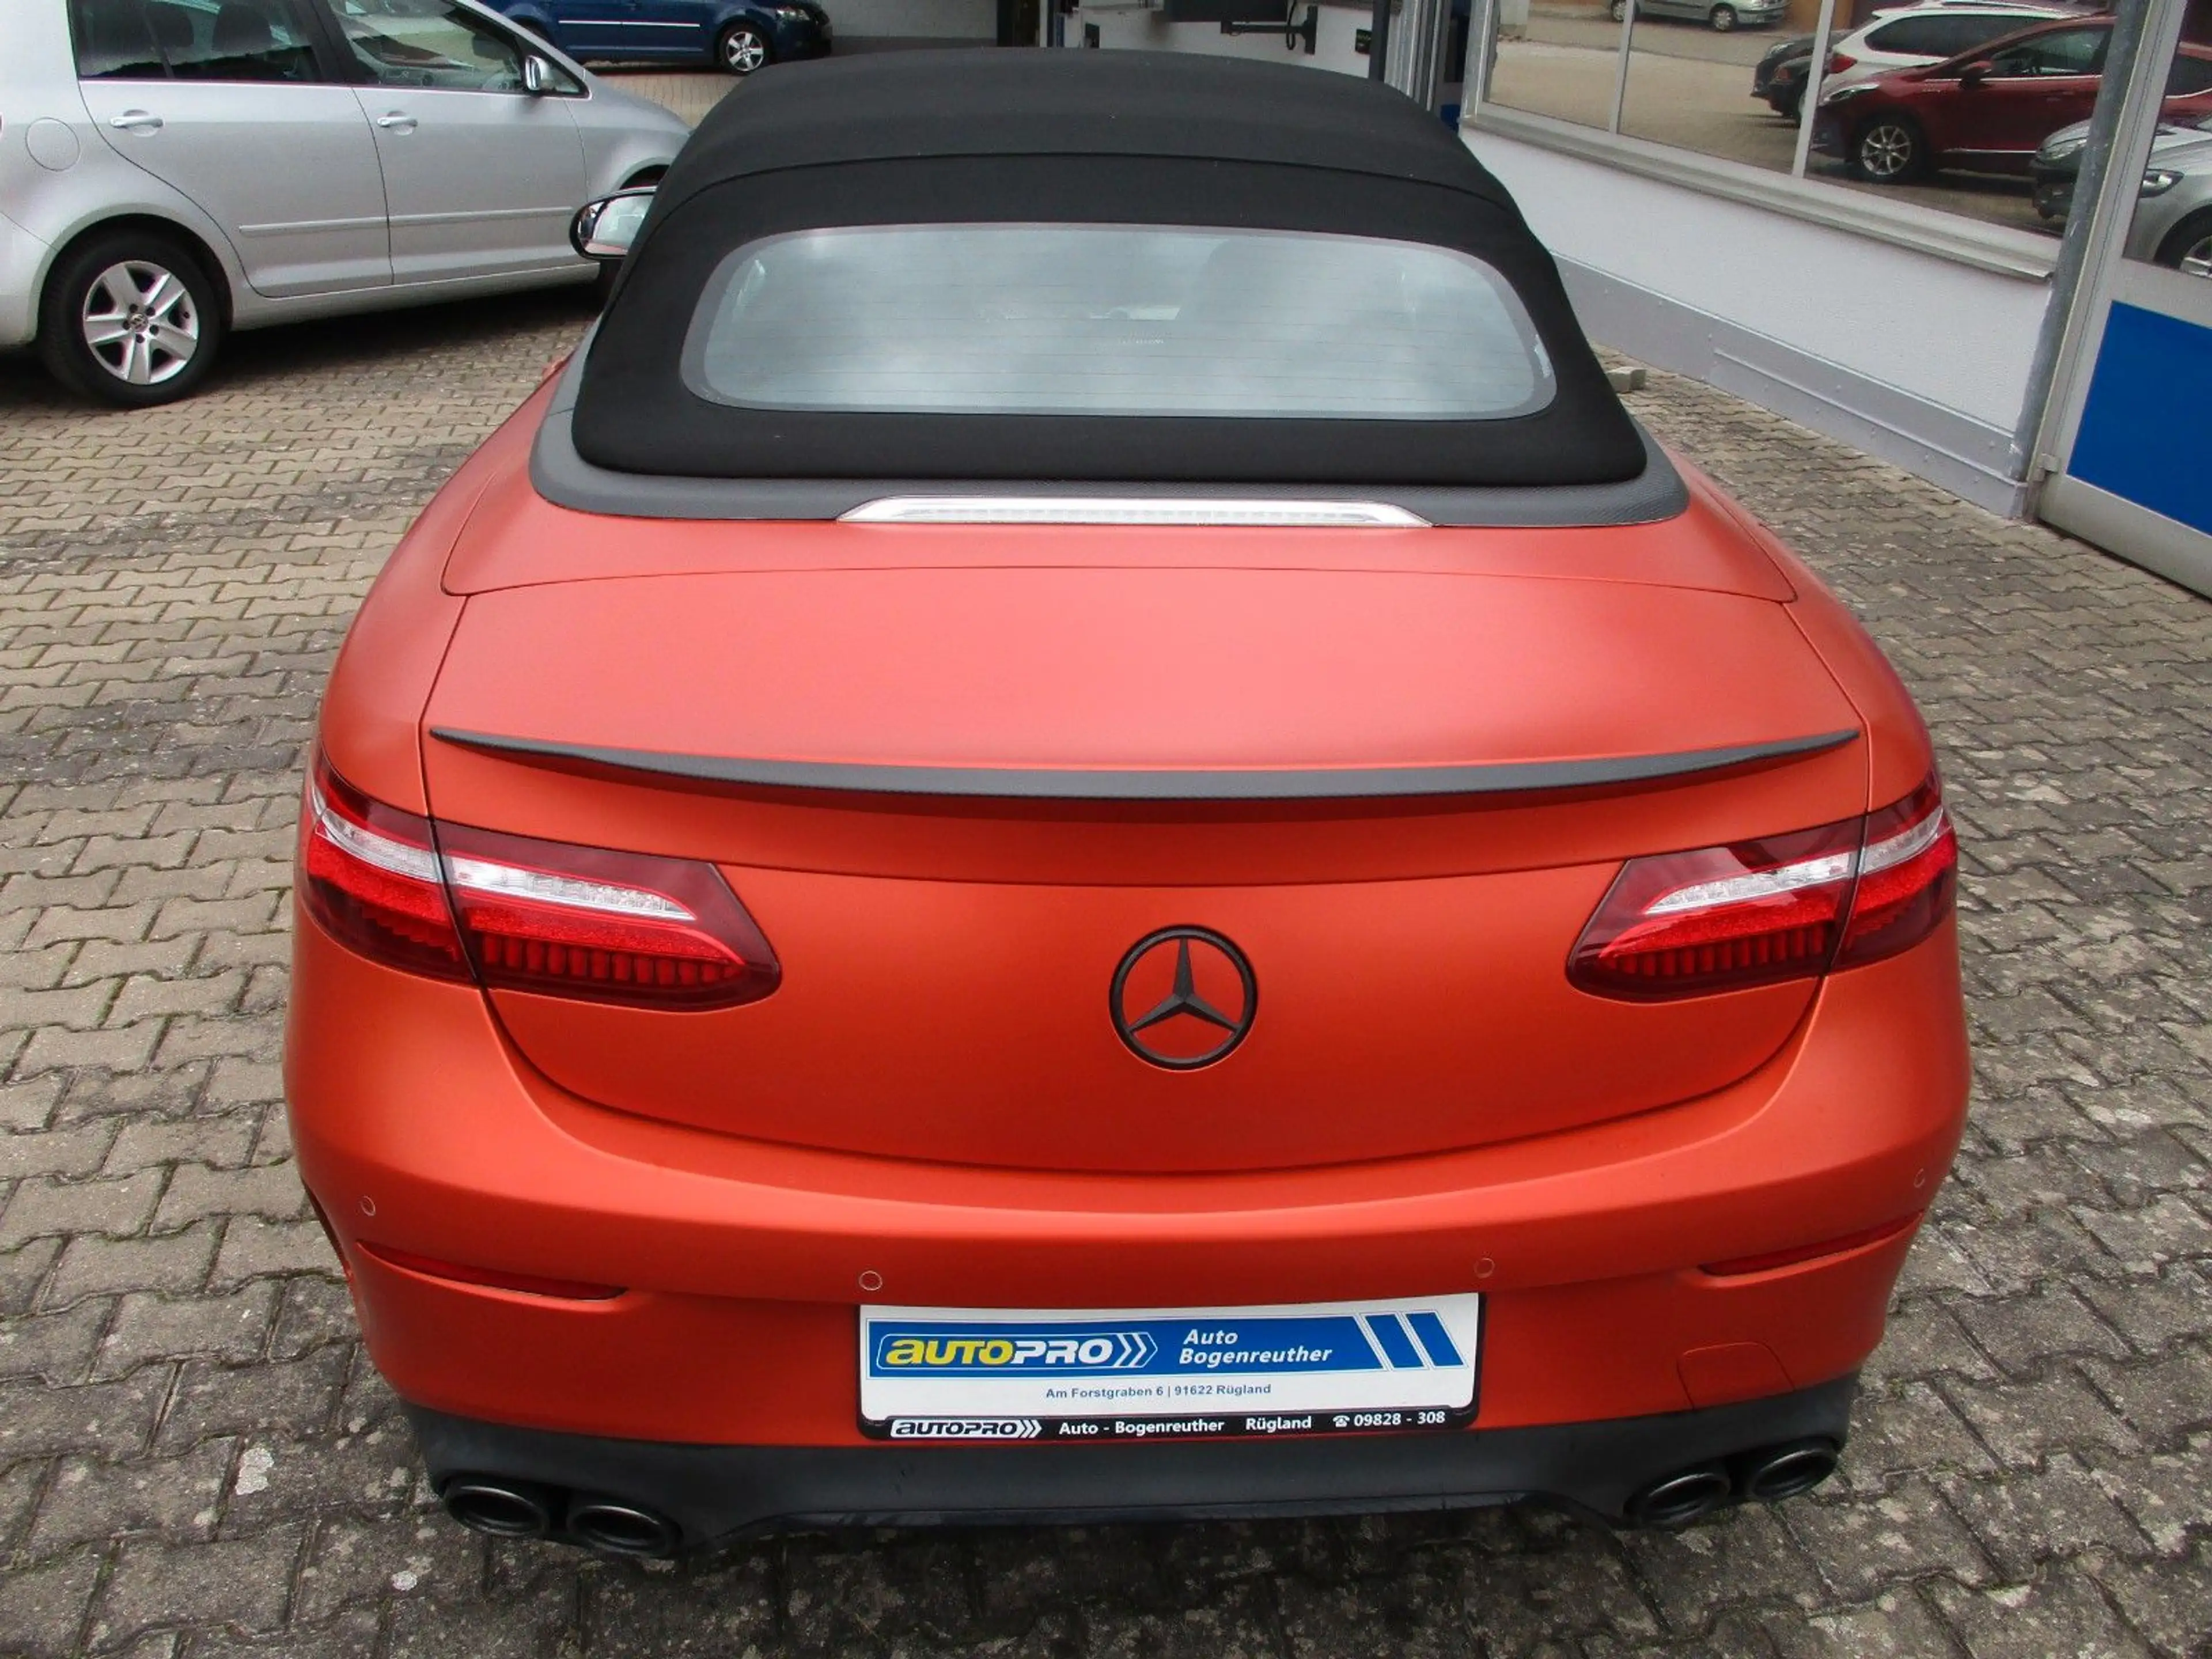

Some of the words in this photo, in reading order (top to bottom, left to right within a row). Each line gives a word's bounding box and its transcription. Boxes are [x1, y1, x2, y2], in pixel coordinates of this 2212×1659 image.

[1183, 1328, 1238, 1345] Auto
[1179, 1345, 1332, 1369] Bogenreuther
[1046, 1388, 1067, 1399] Am
[1071, 1387, 1153, 1400] Forstgraben
[1156, 1386, 1164, 1396] 6
[1174, 1385, 1213, 1396] 91622
[1216, 1384, 1272, 1396] Rügland
[1059, 1422, 1099, 1435] Auto
[1115, 1419, 1225, 1437] Bogenreuther
[1245, 1415, 1312, 1434] Rügland
[1354, 1413, 1402, 1427] 09828
[1417, 1411, 1446, 1425] 308
